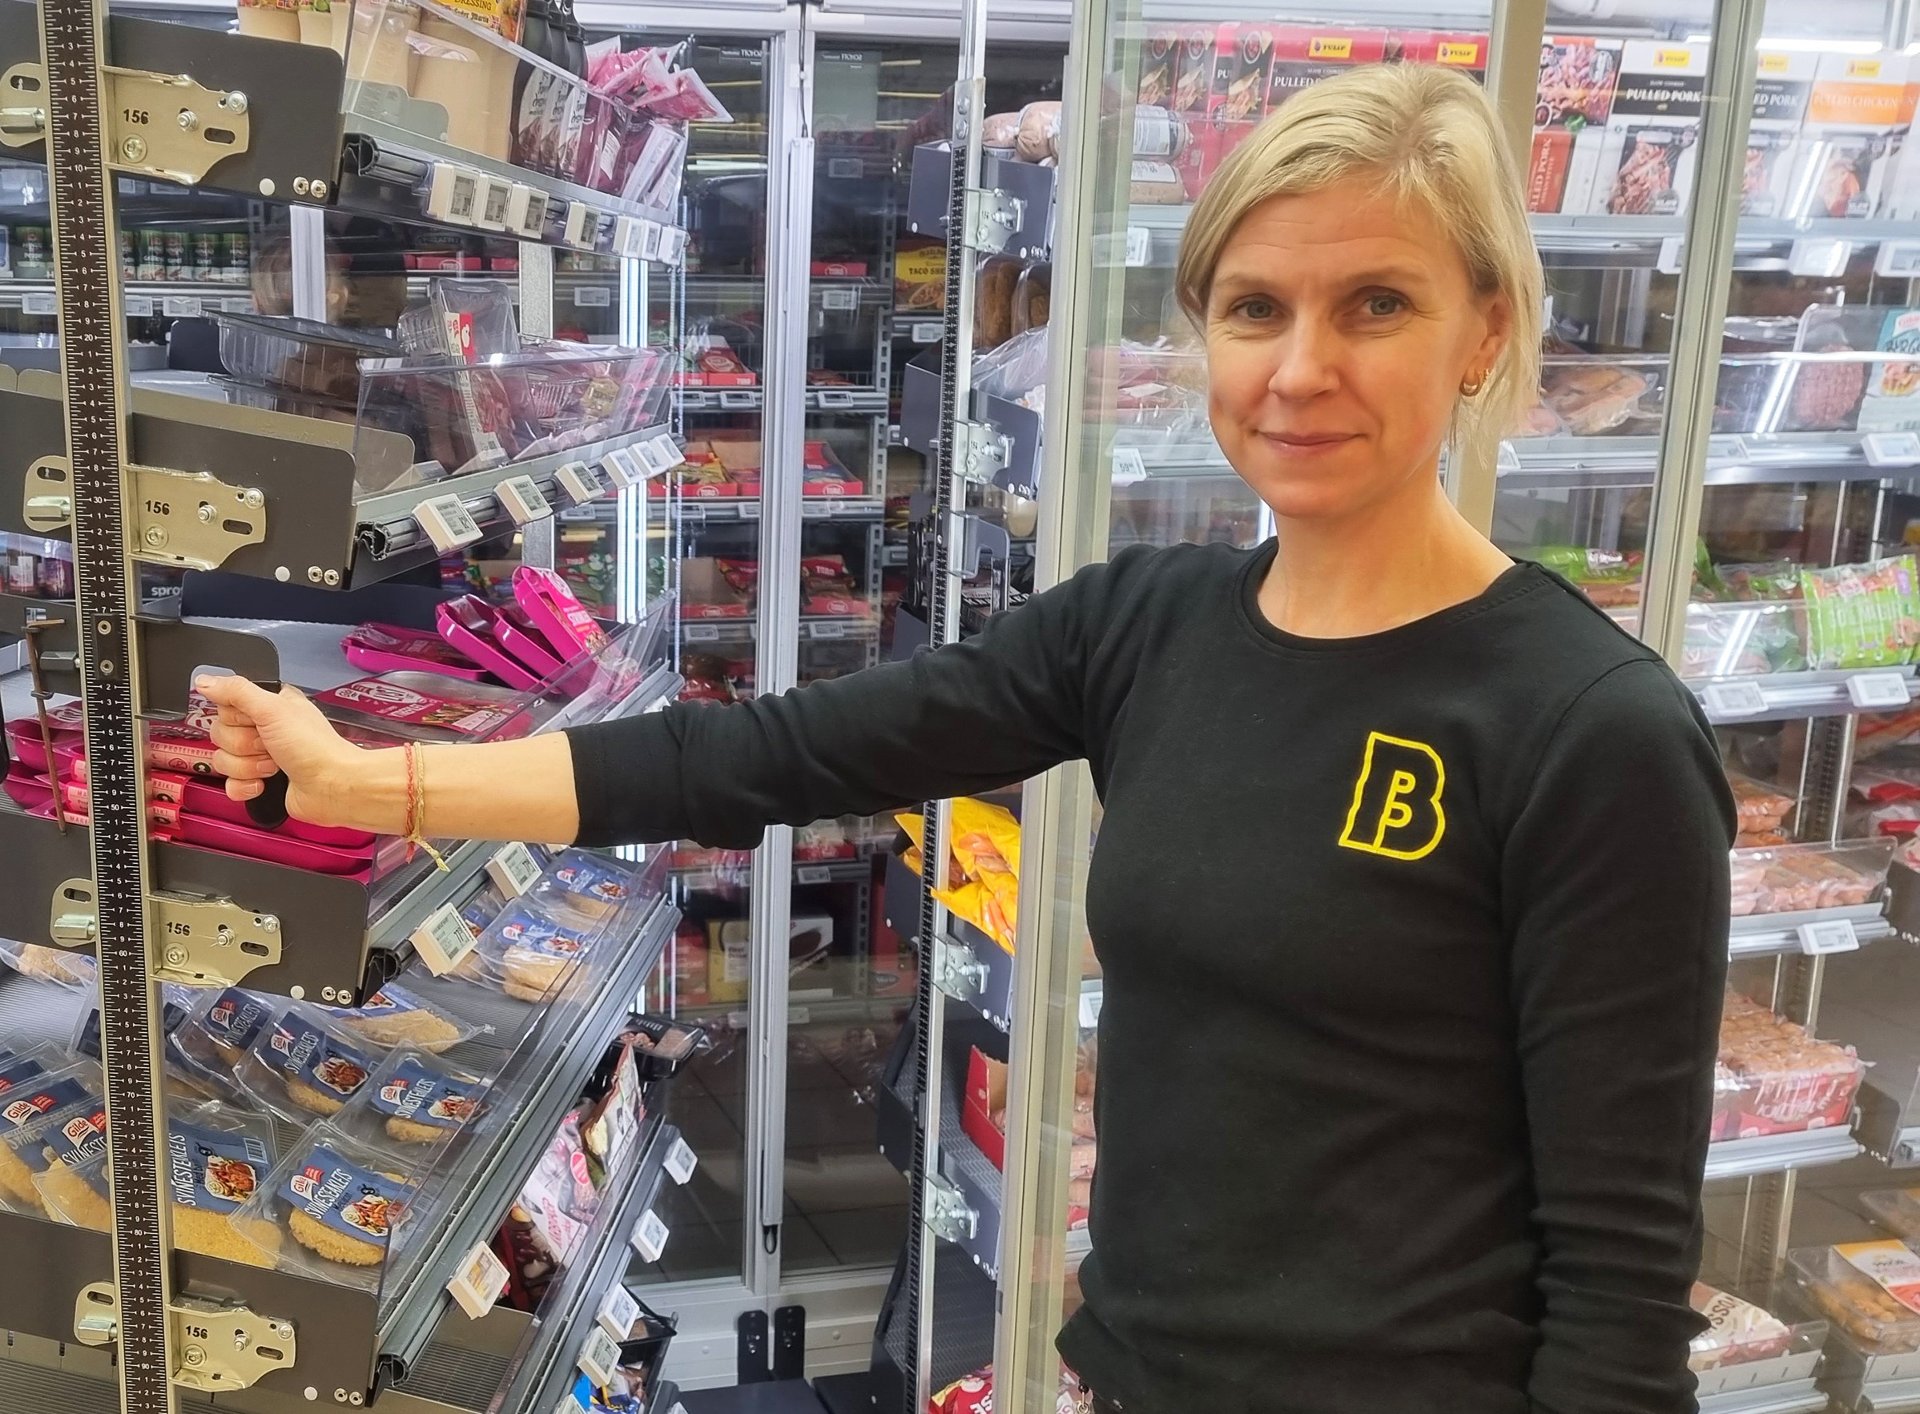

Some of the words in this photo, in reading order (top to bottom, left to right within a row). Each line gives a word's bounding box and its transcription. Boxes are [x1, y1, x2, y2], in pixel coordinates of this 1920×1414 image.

[67, 7, 71, 15] 1
[67, 24, 72, 33] 2
[68, 42, 74, 51] 3
[69, 60, 74, 68] 4
[70, 77, 76, 86] 5
[71, 94, 77, 104] 6
[1626, 88, 1669, 102] PULLED
[1670, 90, 1702, 103] PORK
[73, 112, 78, 120] 7
[123, 108, 150, 125] 156
[73, 129, 79, 138] 8
[74, 146, 80, 155] 9
[74, 164, 83, 173] 10
[77, 198, 83, 207] 2
[78, 215, 84, 224] 3
[79, 233, 85, 241] 4
[81, 250, 86, 258] 5
[82, 266, 87, 275] 6
[909, 268, 928, 276] TACO
[83, 283, 88, 292] 7
[84, 300, 90, 309] 8
[85, 317, 91, 325] 9
[84, 333, 94, 342] 20
[88, 350, 92, 358] 1
[88, 366, 93, 375] 2
[89, 383, 94, 391] 3
[91, 415, 96, 424] 5
[91, 432, 97, 440] 6
[93, 448, 98, 456] 7
[93, 464, 99, 472] 8
[94, 480, 100, 488] 9
[93, 496, 103, 504] 30
[144, 500, 171, 517] 156
[98, 512, 101, 520] 1
[97, 528, 103, 536] 2
[98, 543, 103, 551] 3
[816, 565, 835, 576] TORO
[100, 575, 105, 583] 5
[100, 590, 106, 598] 6
[102, 606, 107, 614] 7
[106, 683, 111, 691] 2
[107, 698, 112, 706] 3
[108, 728, 114, 736] 5
[111, 774, 116, 782] 8
[114, 833, 119, 841] 2
[115, 848, 120, 856] 3
[117, 877, 122, 885] 5
[119, 906, 123, 914] 7
[165, 921, 191, 937] 156
[122, 978, 128, 986] 2
[125, 1035, 130, 1043] 6
[127, 1063, 132, 1071] 8
[127, 1077, 133, 1085] 9
[127, 1091, 135, 1099] 70
[7, 1101, 30, 1119] Gilde
[130, 1119, 135, 1127] 2
[67, 1119, 89, 1137] Gilde
[132, 1160, 137, 1168] 5
[133, 1174, 138, 1182] 6
[135, 1215, 140, 1223] 9
[140, 1296, 144, 1304] 5
[184, 1324, 209, 1341] 156
[141, 1336, 147, 1344] 8
[141, 1362, 150, 1370] 90
